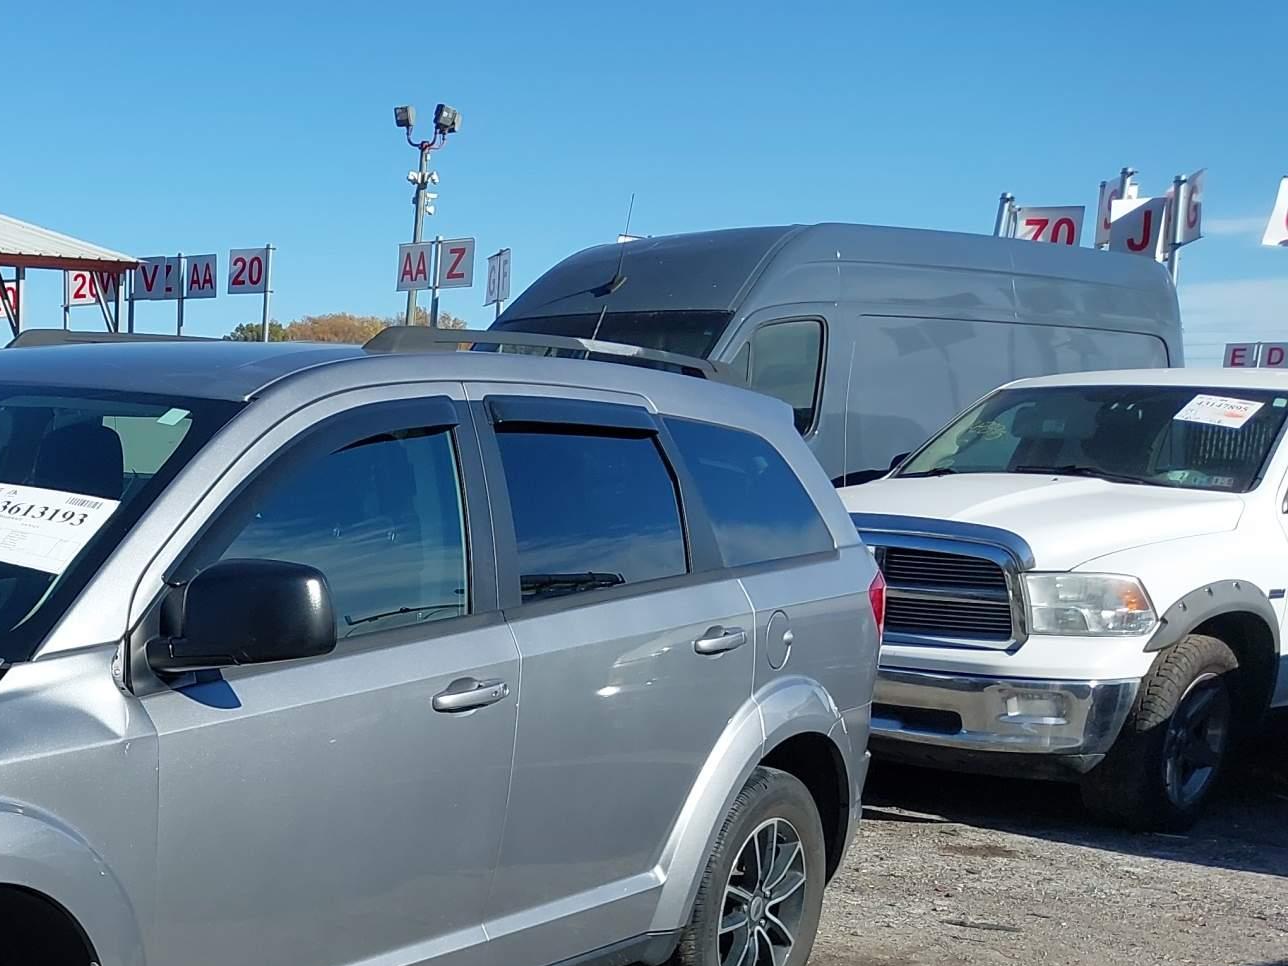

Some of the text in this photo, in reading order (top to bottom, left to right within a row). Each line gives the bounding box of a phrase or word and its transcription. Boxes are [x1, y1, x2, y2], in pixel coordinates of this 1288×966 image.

[1126, 209, 1153, 252] J
[140, 264, 160, 293] V
[189, 262, 214, 291] AA
[231, 255, 263, 287] 20
[400, 250, 428, 283] AA
[446, 247, 467, 280] Z
[1230, 347, 1248, 368] E
[1266, 347, 1285, 366] D
